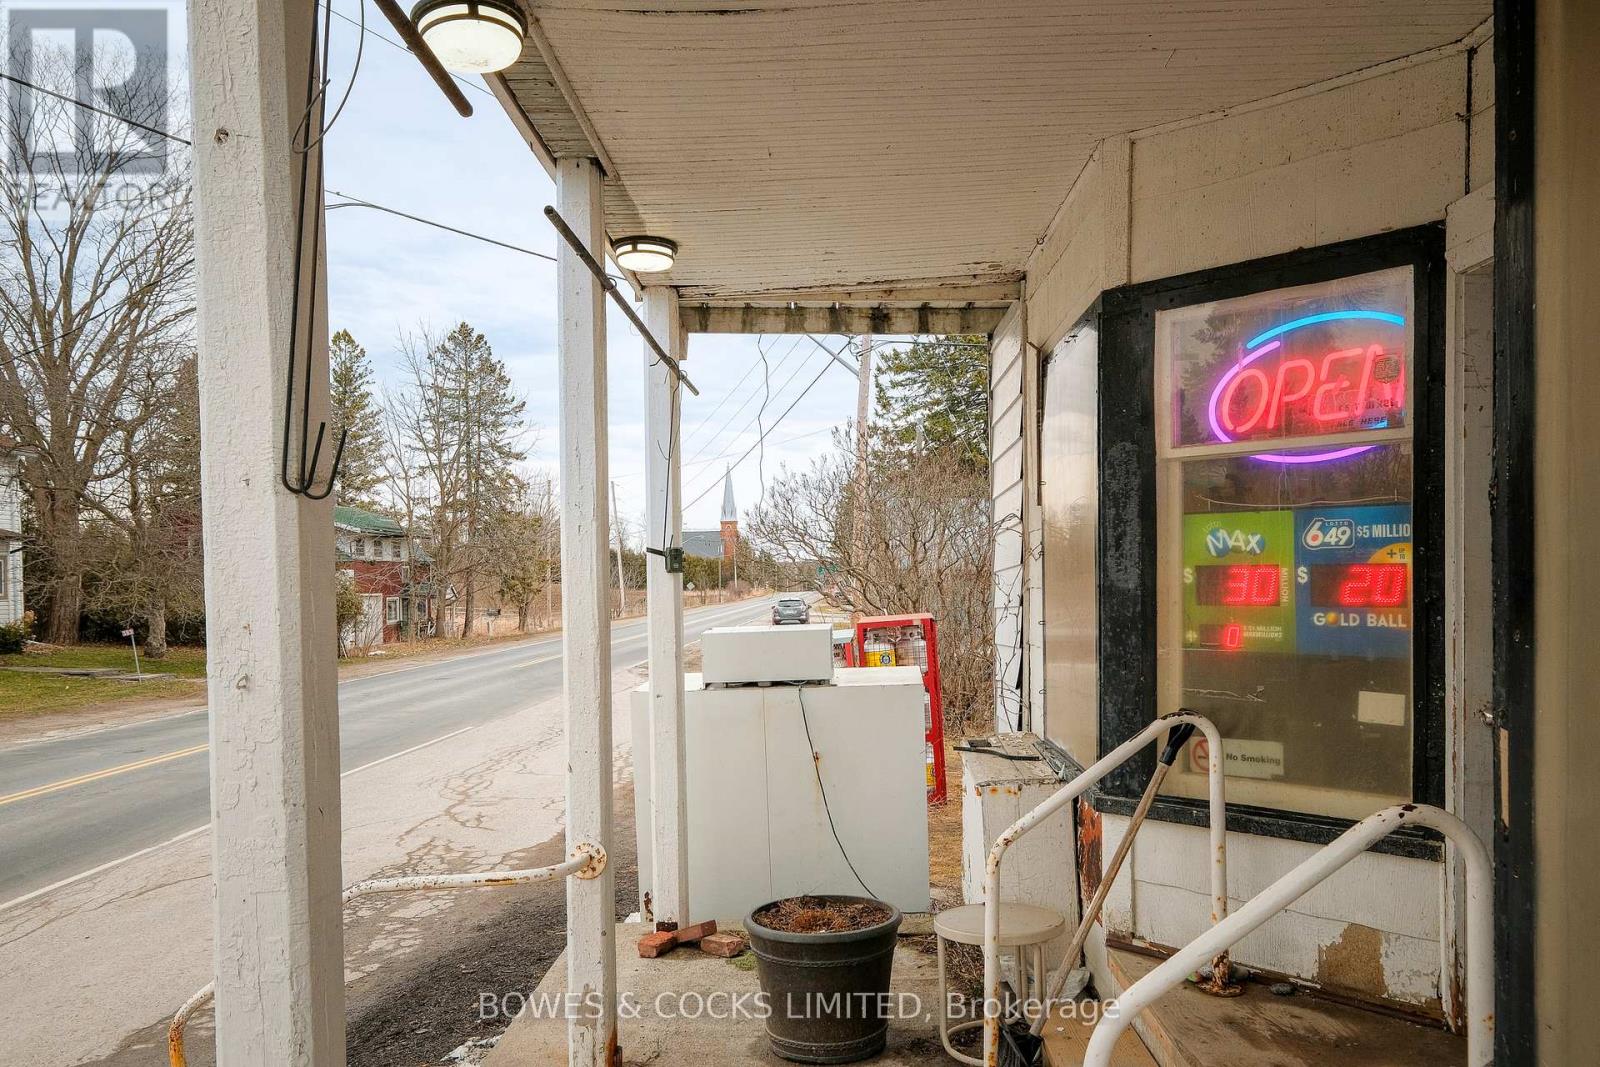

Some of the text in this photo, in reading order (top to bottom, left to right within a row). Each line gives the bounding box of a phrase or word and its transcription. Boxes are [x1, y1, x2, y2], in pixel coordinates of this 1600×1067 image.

[1222, 344, 1405, 432] OPEN
[1356, 525, 1370, 538] $5
[1206, 528, 1261, 556] MAX
[1183, 568, 1193, 584] $
[1226, 567, 1278, 603] 30
[1297, 566, 1309, 584] $
[1343, 566, 1405, 603] 20
[1367, 612, 1407, 628] BALL
[1227, 626, 1240, 648] 0
[1226, 753, 1280, 766] No Smoking
